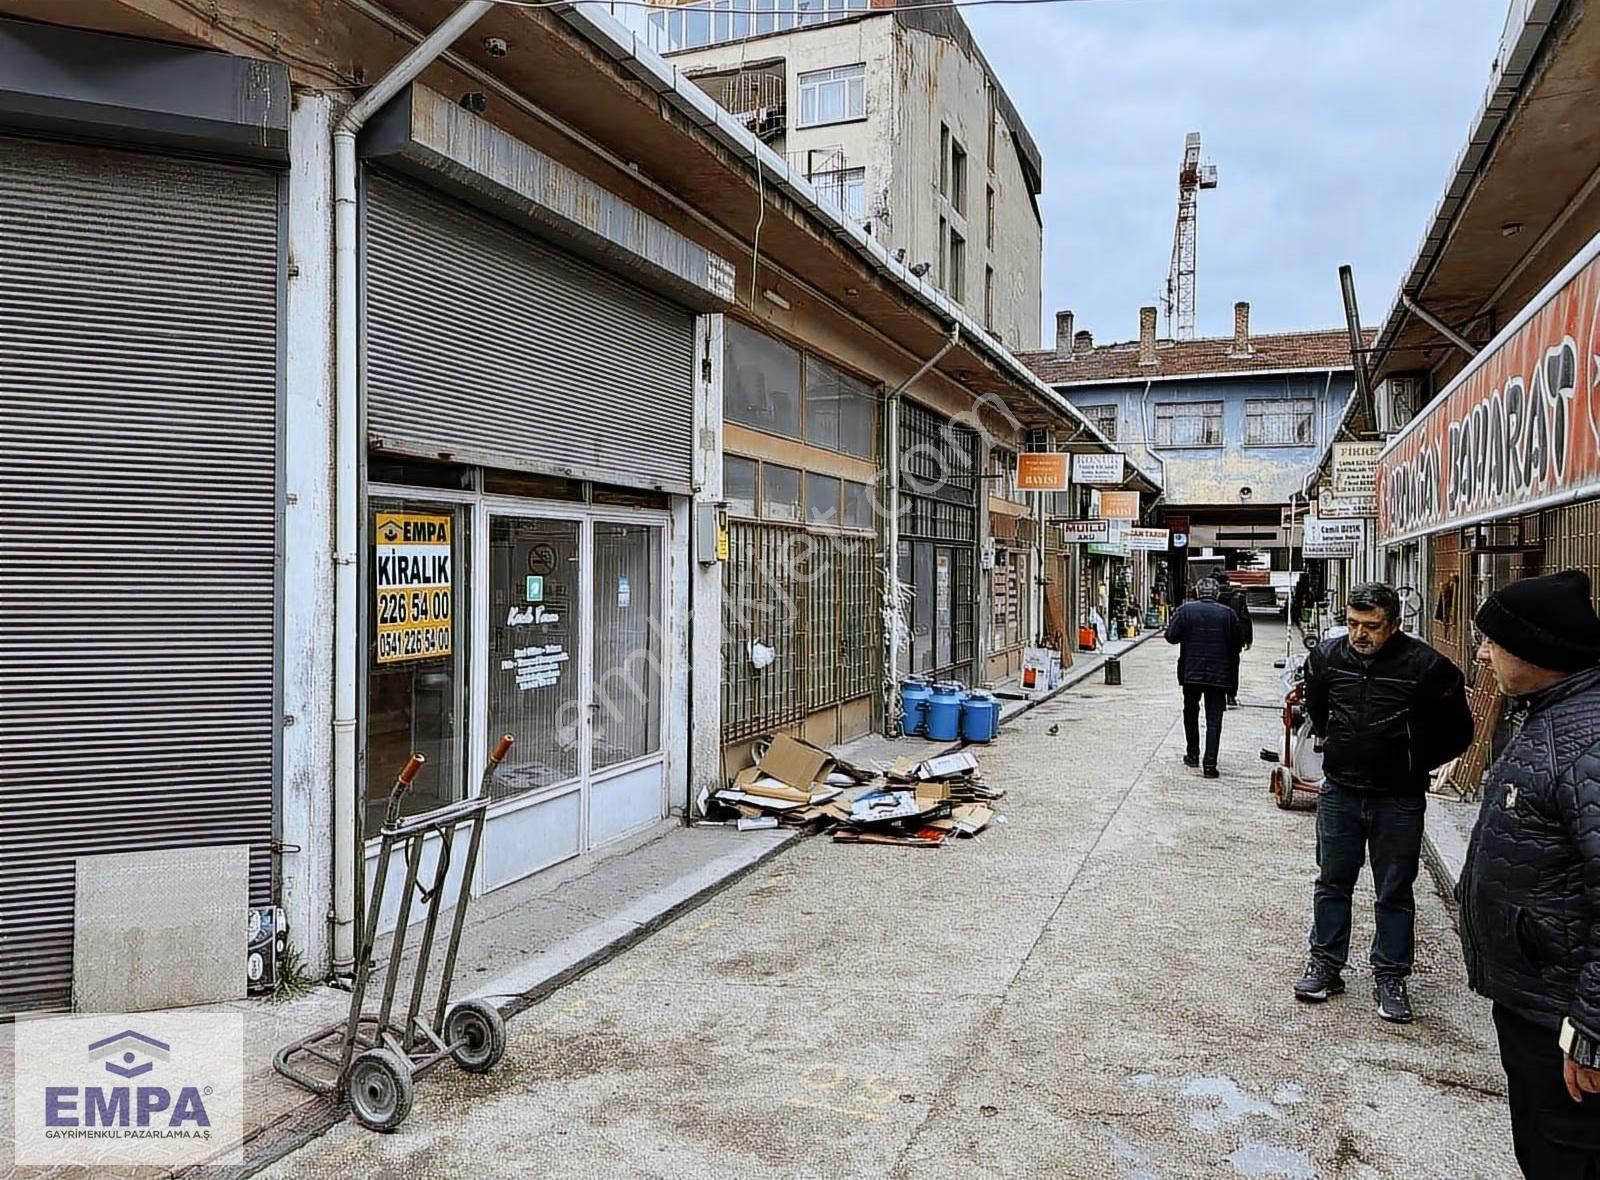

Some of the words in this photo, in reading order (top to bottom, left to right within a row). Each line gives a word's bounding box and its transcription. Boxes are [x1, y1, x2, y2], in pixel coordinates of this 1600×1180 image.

[1447, 335, 1577, 517] BAHARAT
[403, 521, 447, 542] EMPA
[378, 548, 449, 585] KİRALIK
[379, 593, 407, 625] 226
[411, 592, 428, 622] 54
[432, 591, 449, 620] 00
[404, 630, 422, 655] 226
[424, 628, 436, 651] 54
[438, 626, 449, 650] 00
